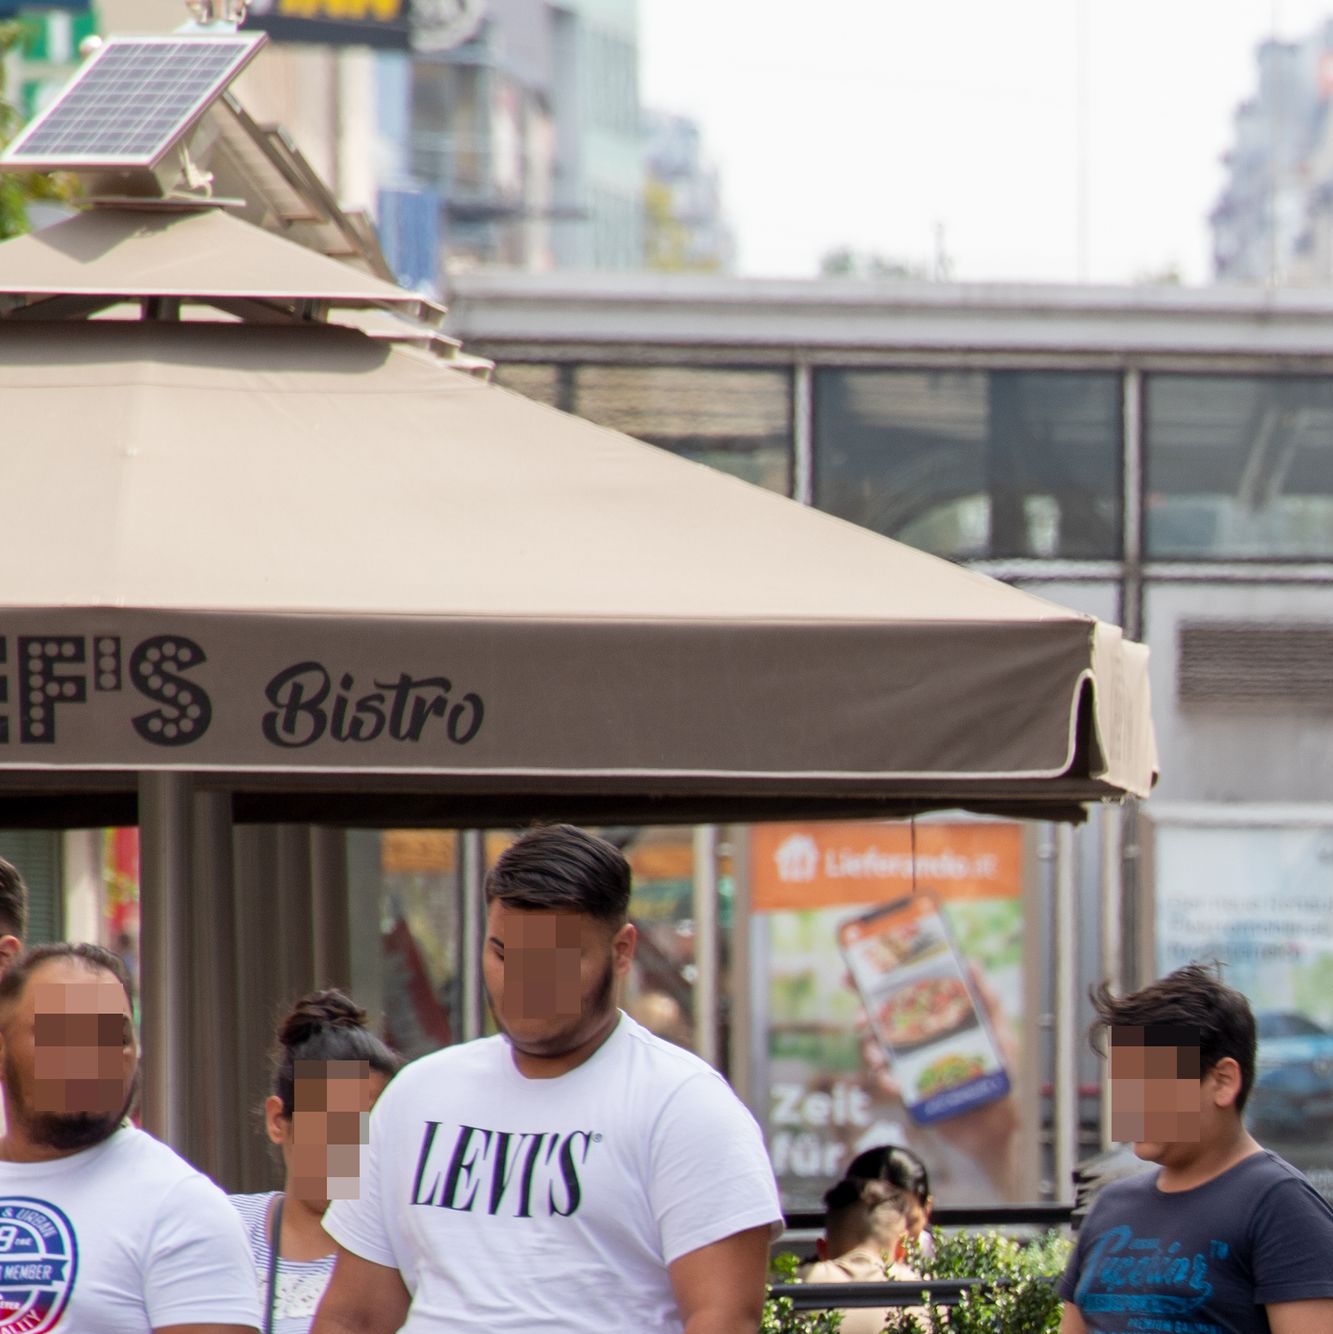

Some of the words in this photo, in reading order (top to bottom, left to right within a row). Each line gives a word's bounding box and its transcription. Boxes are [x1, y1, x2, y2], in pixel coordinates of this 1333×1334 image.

[0, 635, 213, 747] F'S
[261, 660, 485, 748] Bistro
[769, 1082, 871, 1126] Zeit
[410, 1121, 592, 1218] LEVI'S
[770, 1132, 842, 1178] für
[4, 1264, 54, 1281] MEMBER
